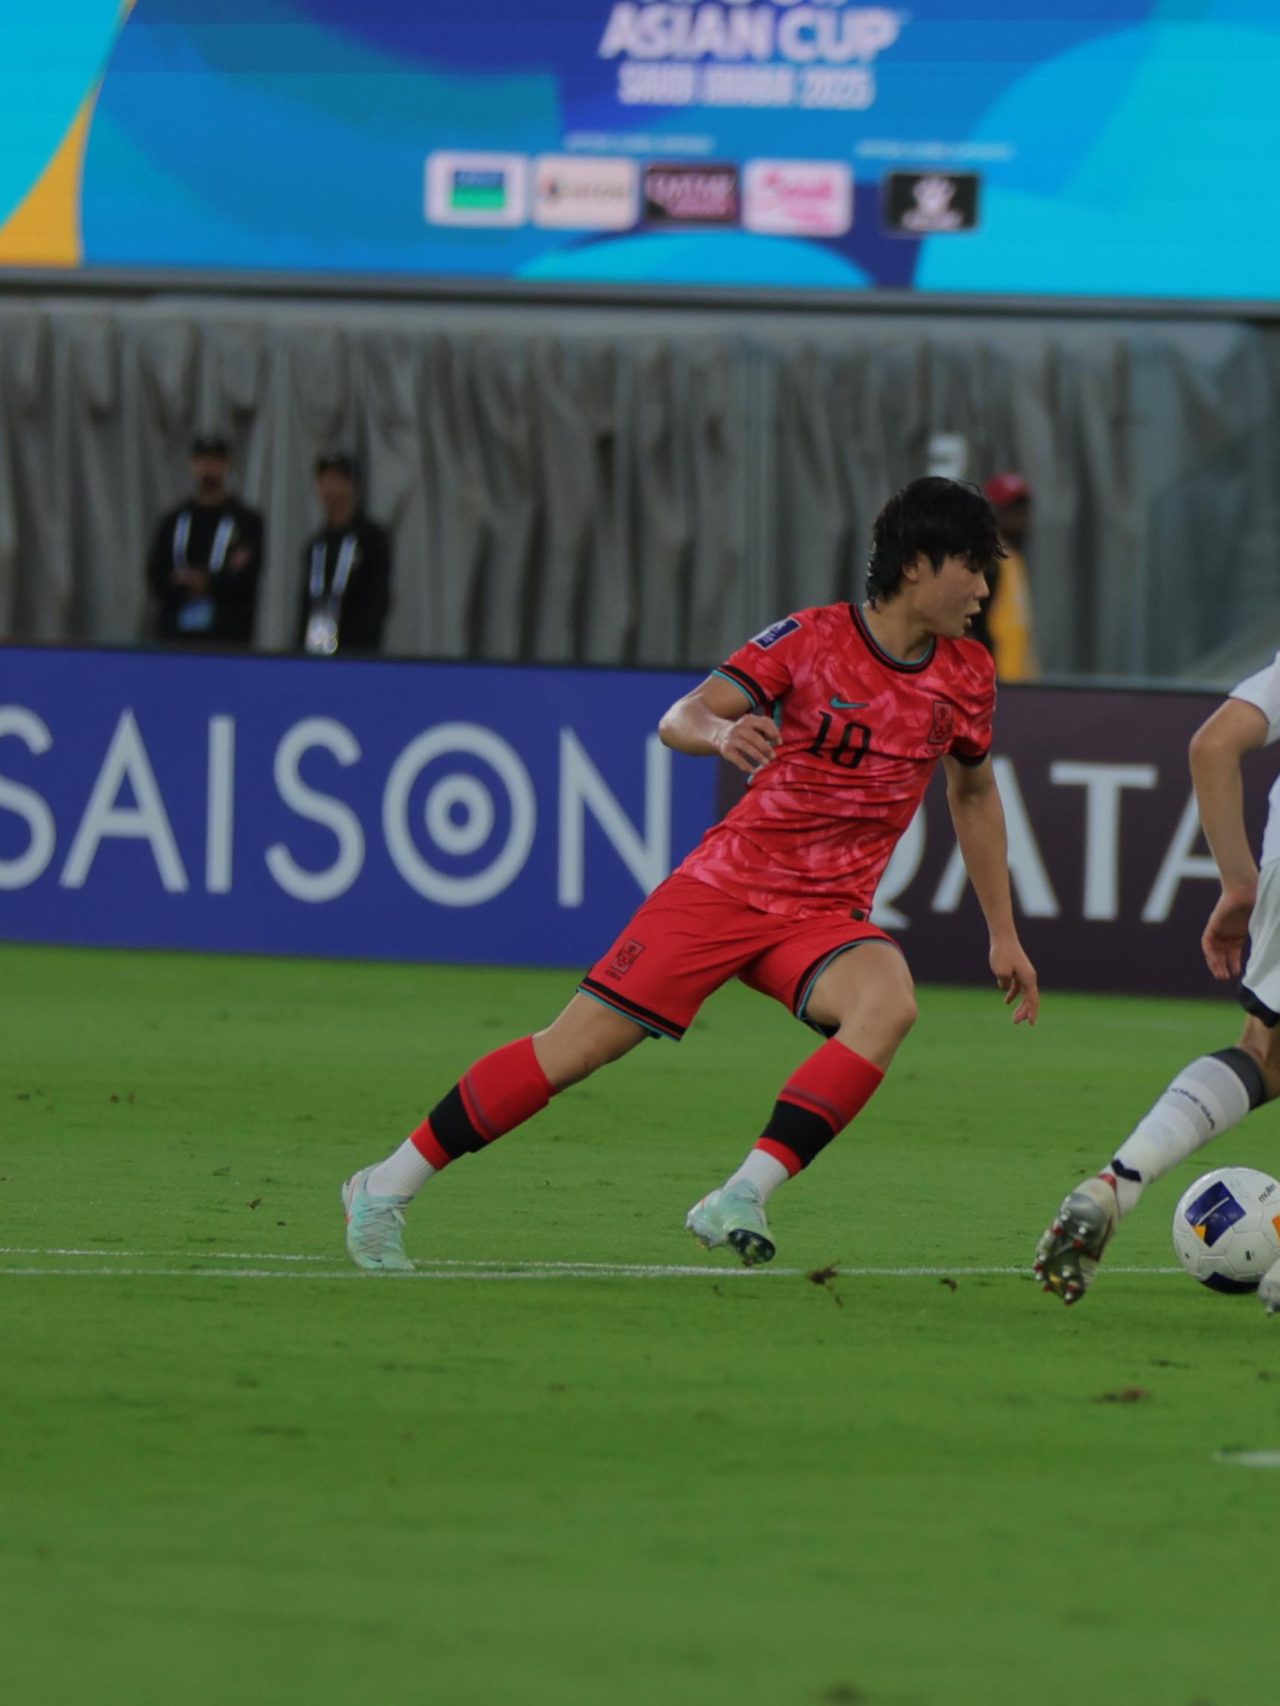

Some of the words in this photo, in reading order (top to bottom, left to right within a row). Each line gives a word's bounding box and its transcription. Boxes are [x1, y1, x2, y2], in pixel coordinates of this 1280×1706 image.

[598, 2, 774, 62] ASIAN
[778, 5, 900, 63] CUP
[0, 705, 673, 908] SAISON
